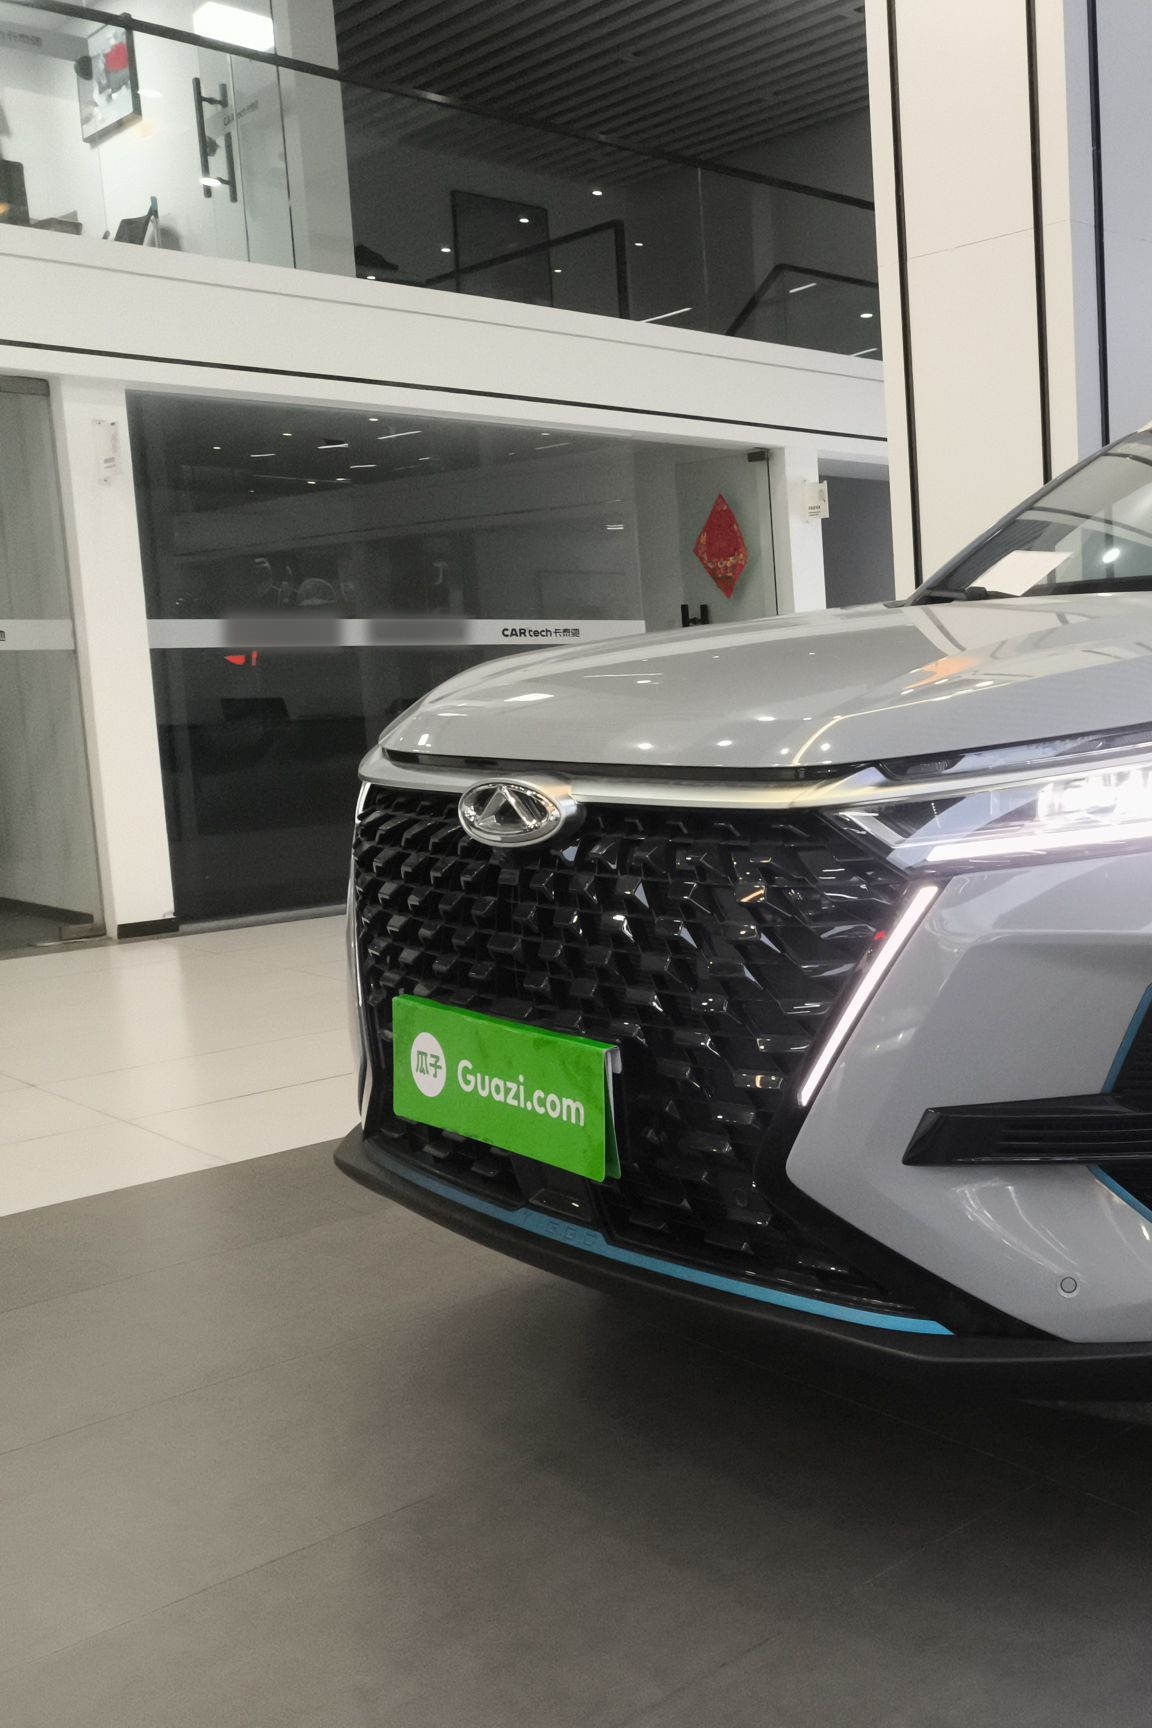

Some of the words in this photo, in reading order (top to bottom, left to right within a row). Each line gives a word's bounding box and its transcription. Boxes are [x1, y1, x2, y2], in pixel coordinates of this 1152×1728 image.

[501, 627, 552, 638] CARtech
[415, 1050, 443, 1079] 瓜子
[457, 1059, 585, 1127] Guazi.com
